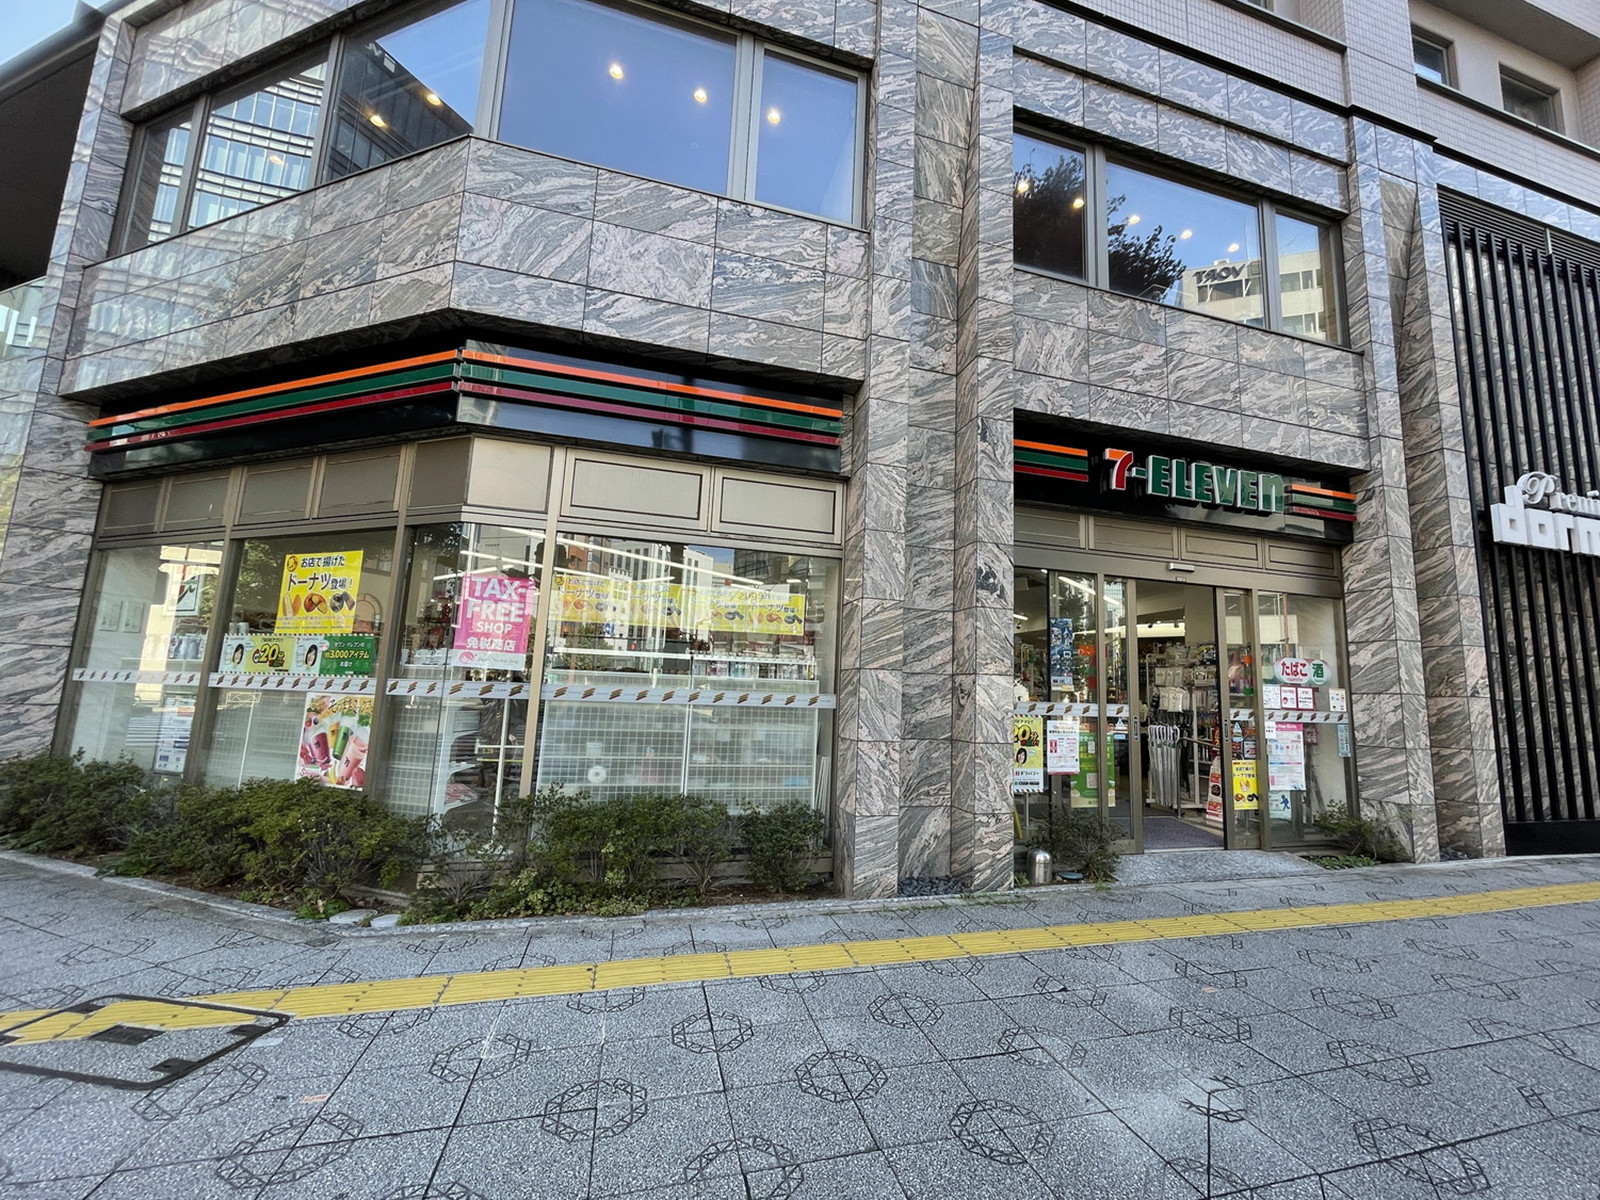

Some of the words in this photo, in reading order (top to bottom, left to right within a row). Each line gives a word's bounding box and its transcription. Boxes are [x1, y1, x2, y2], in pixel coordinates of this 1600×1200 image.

[301, 555, 345, 568] お店で揚げた
[471, 576, 527, 600] TAX-
[466, 597, 525, 623] FREE
[476, 621, 513, 634] SHOP
[1281, 661, 1308, 677] たばこ
[1312, 662, 1325, 678] 酒
